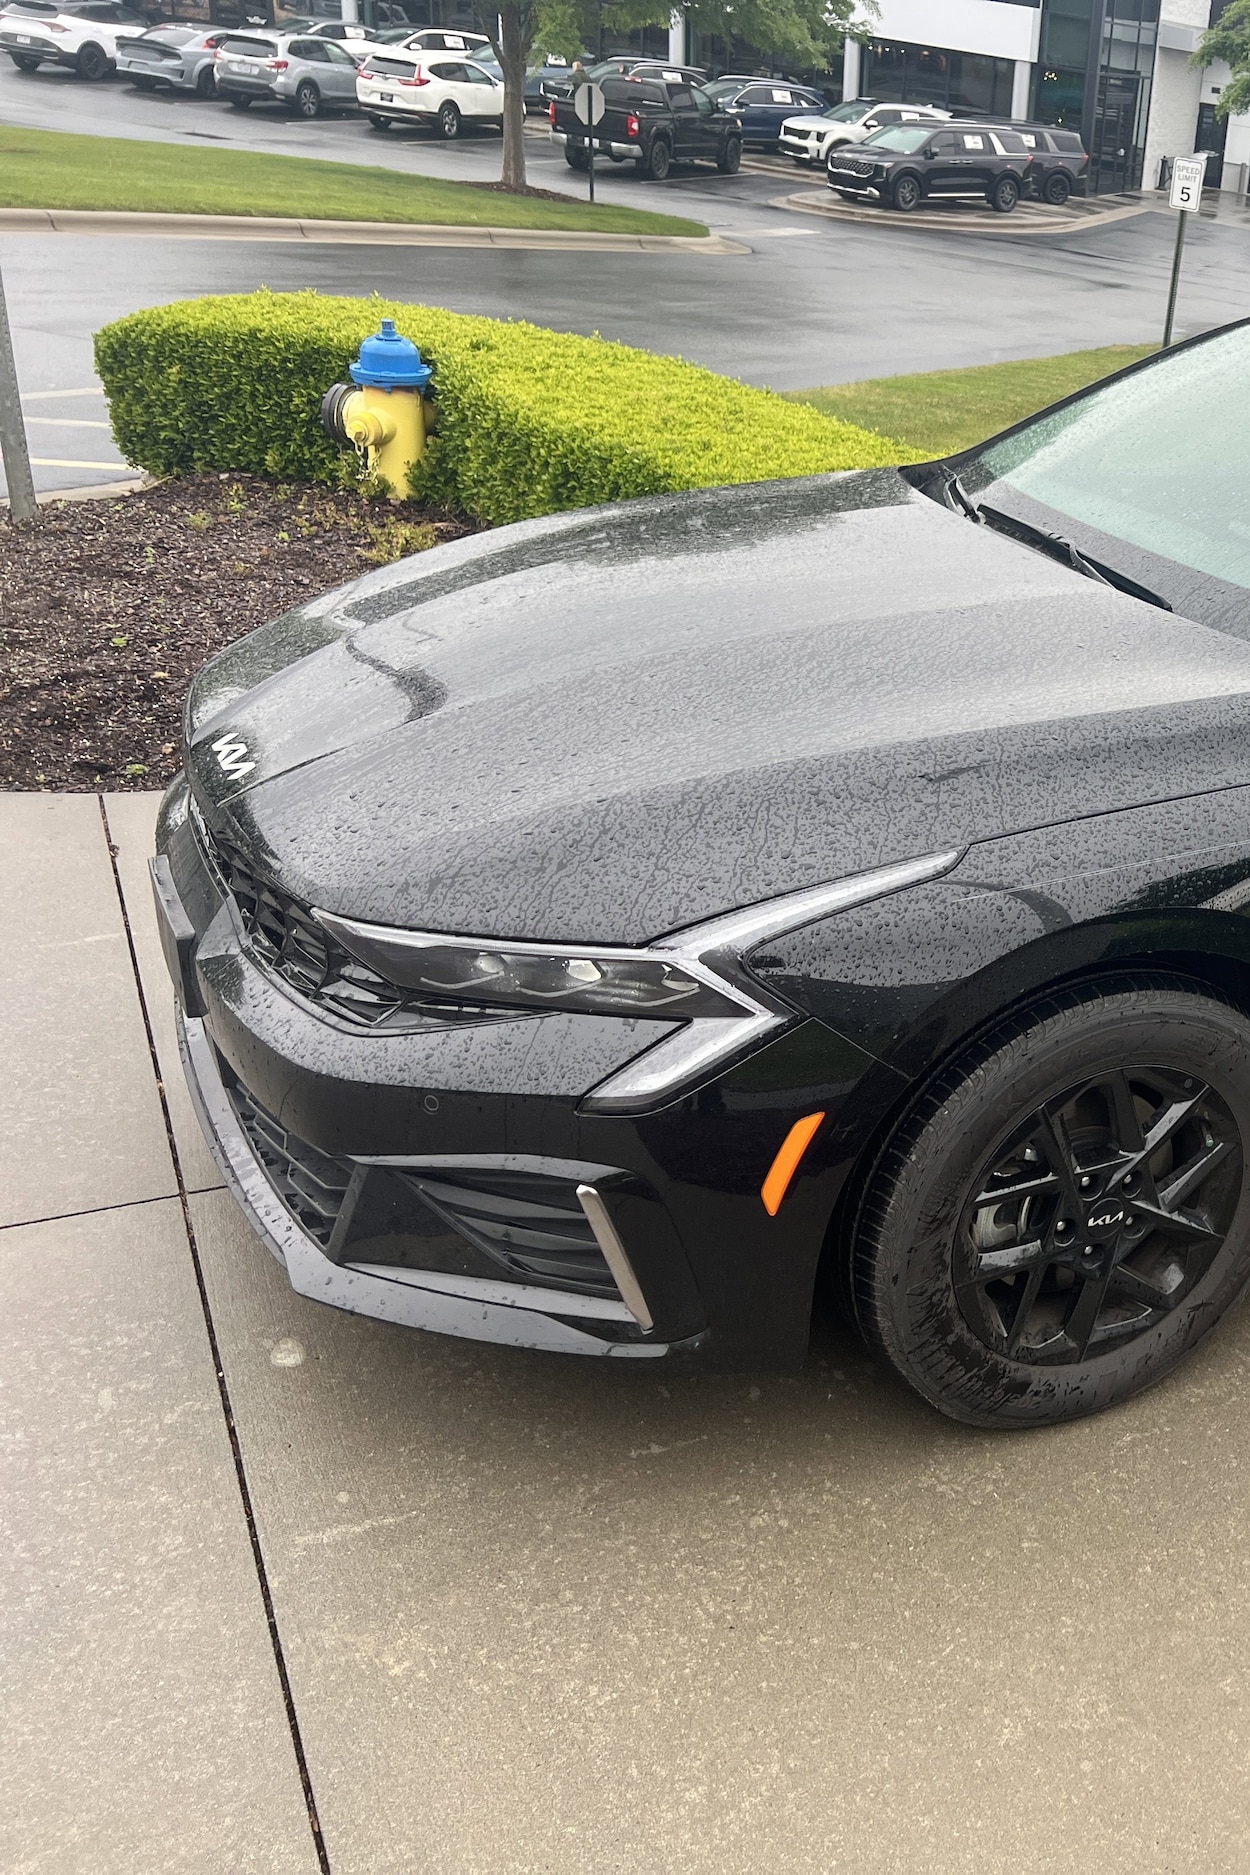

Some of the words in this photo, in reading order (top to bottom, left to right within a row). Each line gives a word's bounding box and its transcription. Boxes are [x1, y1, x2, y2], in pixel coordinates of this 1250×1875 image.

[1176, 165, 1200, 175] SPEED
[1177, 173, 1198, 182] LIMIT
[1180, 186, 1191, 202] 5
[211, 732, 256, 780] KIA
[1088, 1210, 1124, 1228] KIA
